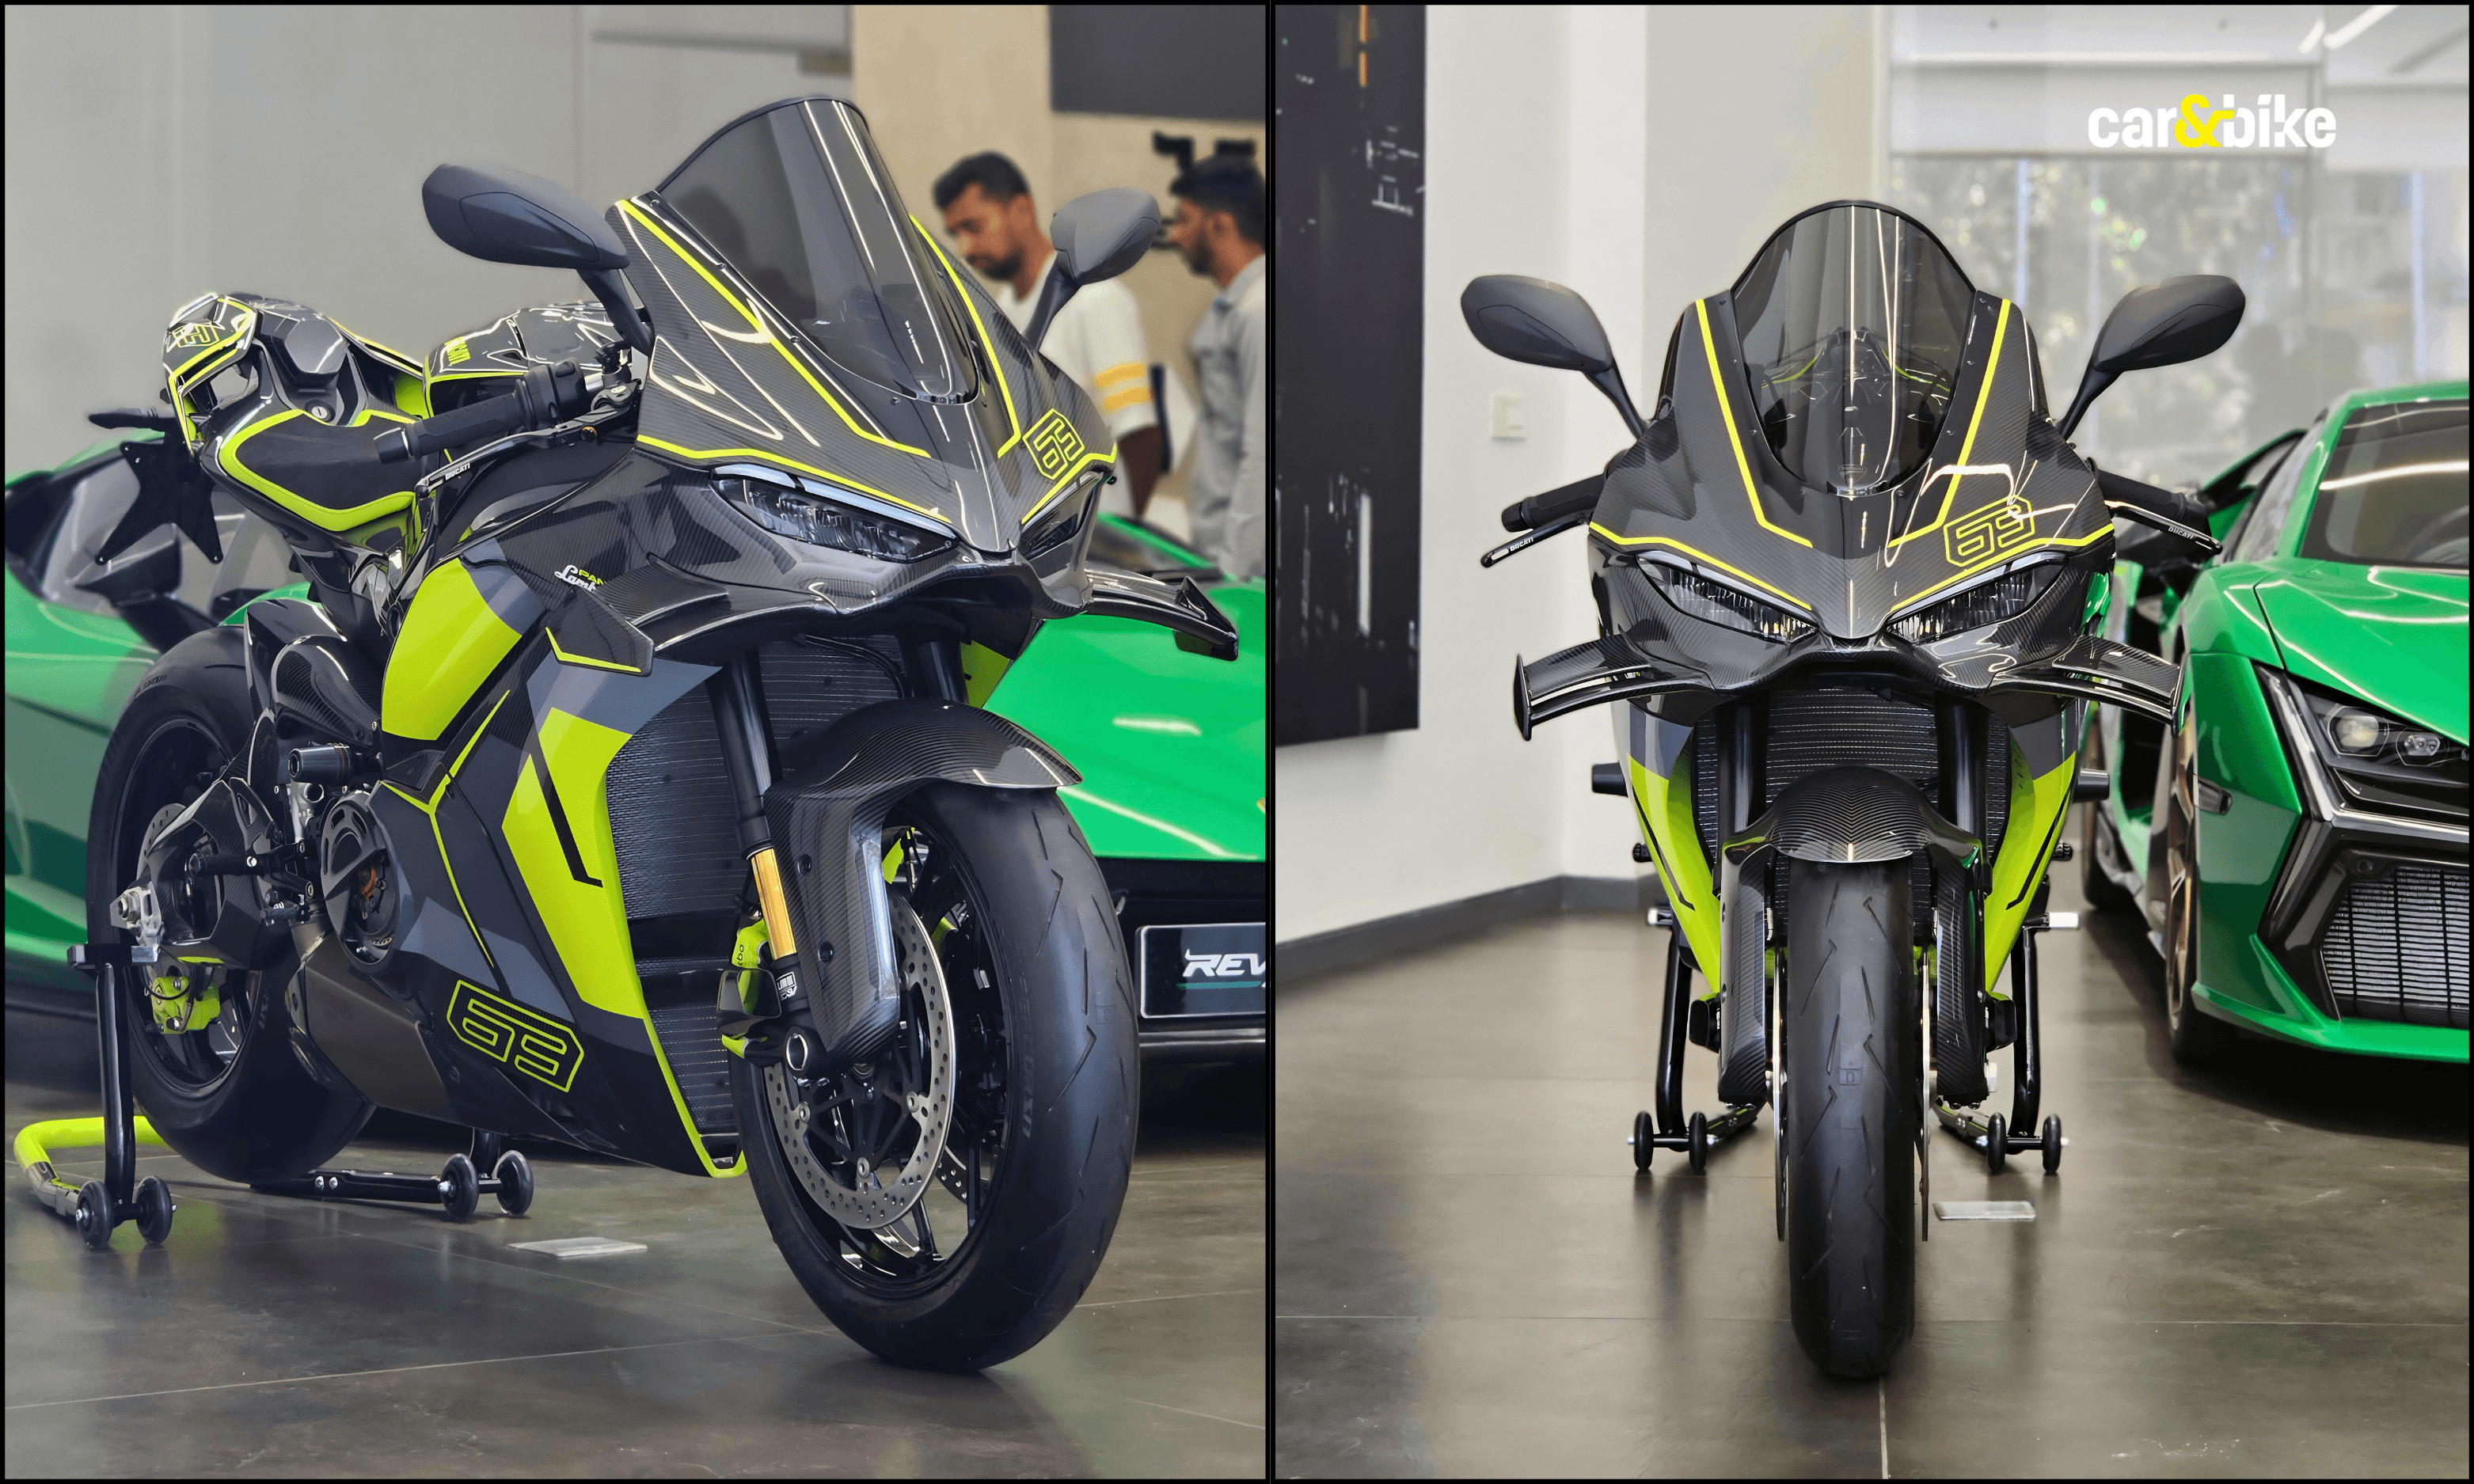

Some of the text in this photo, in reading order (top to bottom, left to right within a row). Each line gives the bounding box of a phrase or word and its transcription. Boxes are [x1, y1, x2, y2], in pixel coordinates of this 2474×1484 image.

[1022, 408, 1085, 480] 63
[1510, 537, 1534, 552] DUCATI
[1943, 495, 2035, 567] 63
[446, 979, 585, 1093] 63
